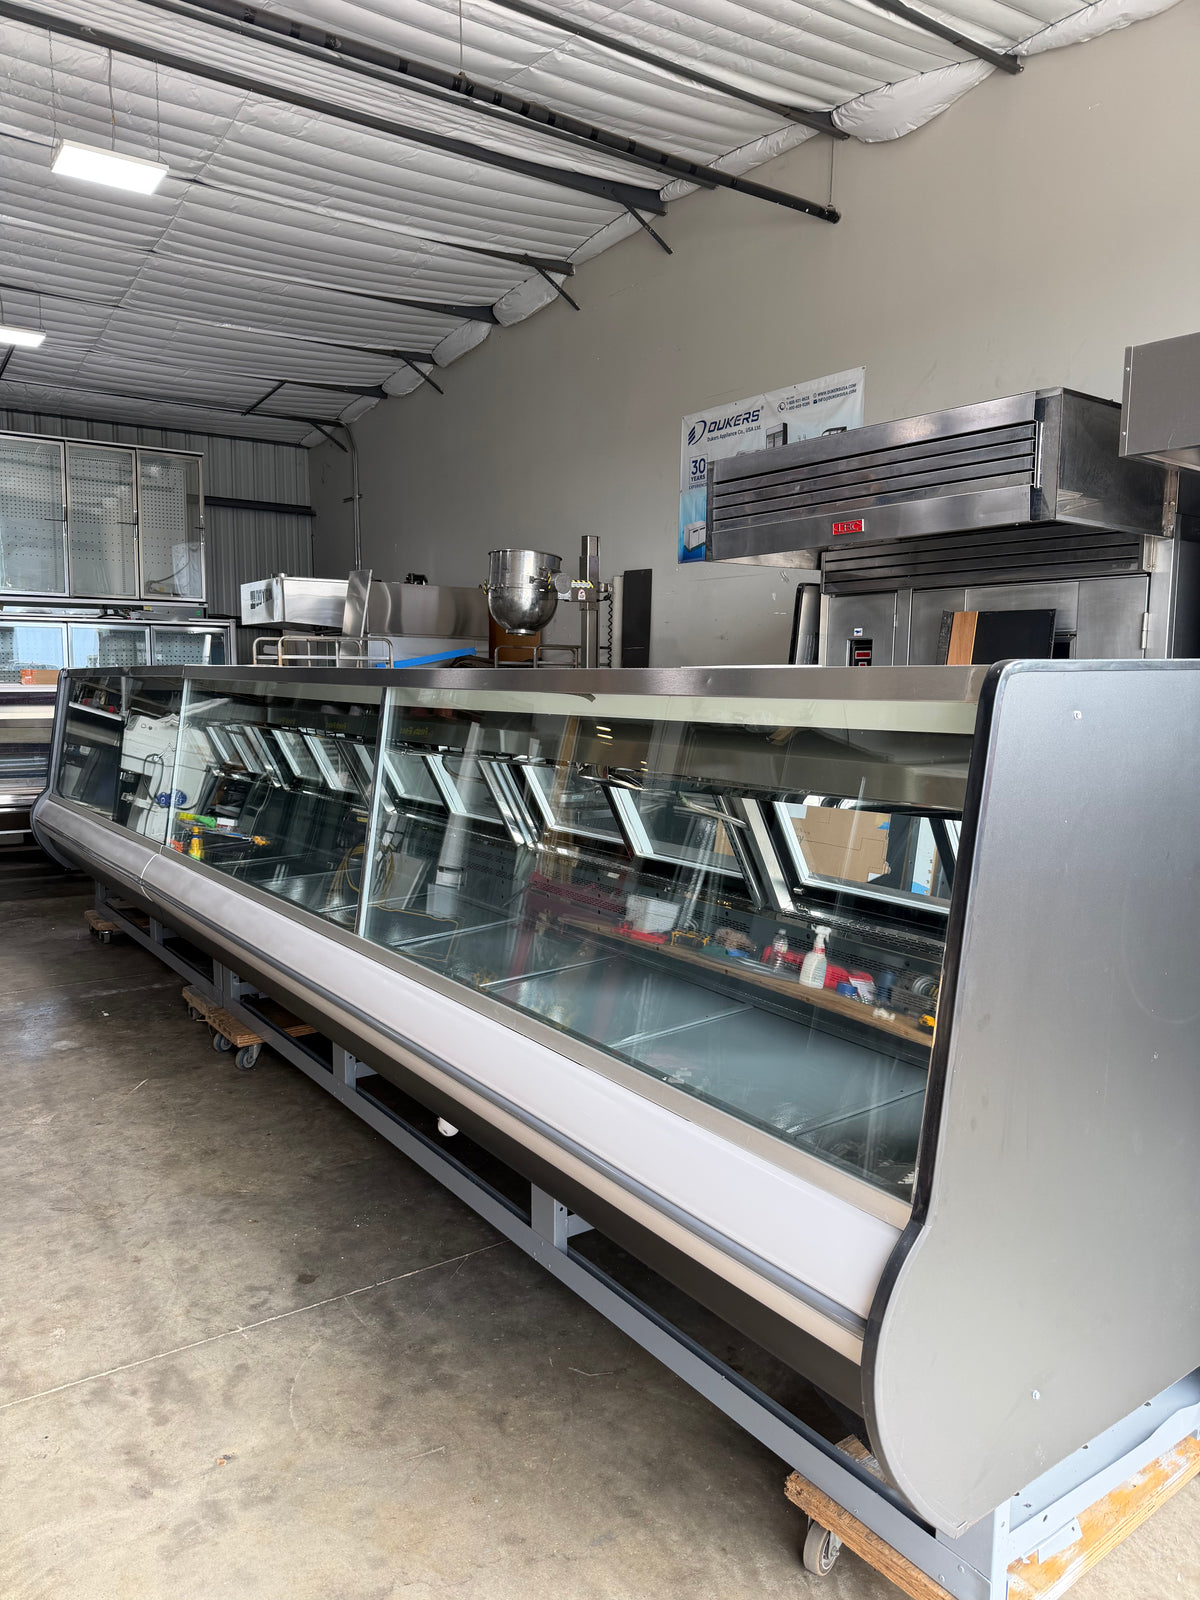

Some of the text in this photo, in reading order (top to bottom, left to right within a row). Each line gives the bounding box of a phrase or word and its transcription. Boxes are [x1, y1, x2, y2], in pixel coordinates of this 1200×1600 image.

[707, 409, 761, 434] DUKERS
[719, 431, 737, 440] Appliance
[691, 458, 706, 476] 30
[690, 474, 706, 482] YEARS
